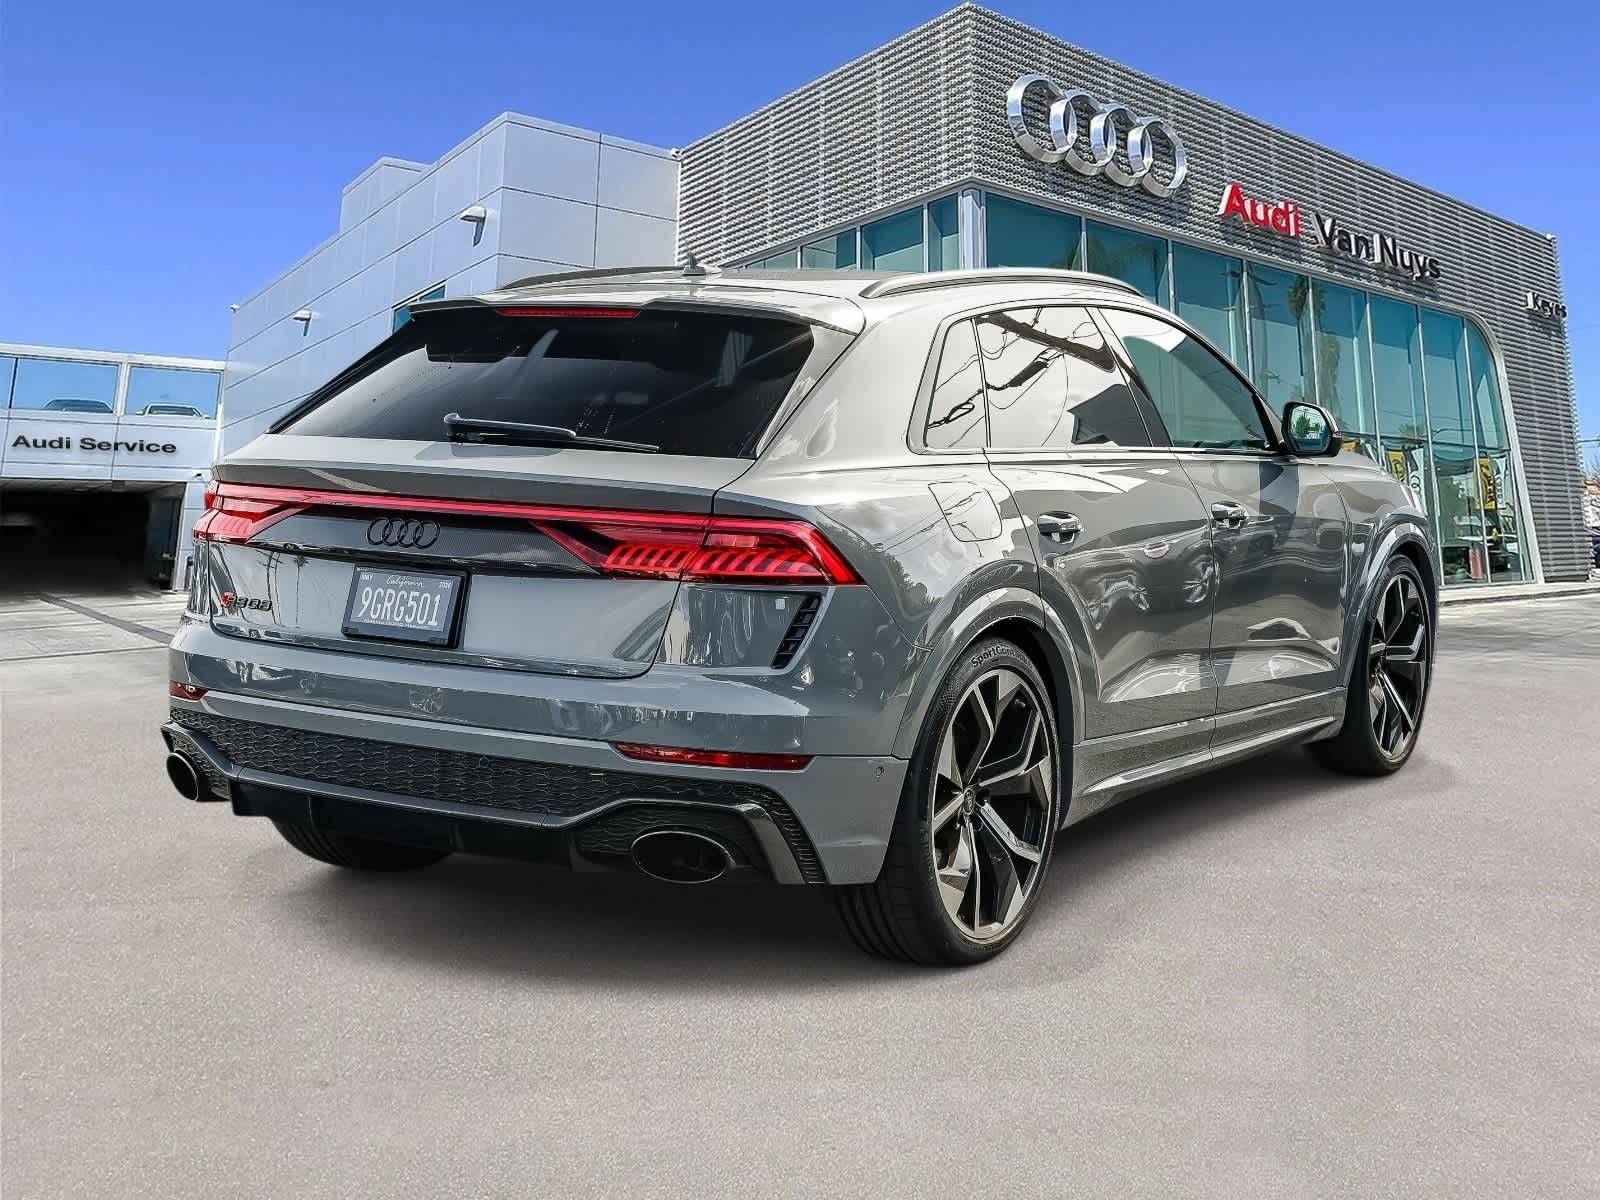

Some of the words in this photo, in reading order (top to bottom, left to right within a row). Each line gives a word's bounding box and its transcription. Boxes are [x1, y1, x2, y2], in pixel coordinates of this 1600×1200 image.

[1218, 183, 1302, 238] Audi
[1312, 212, 1371, 260] Van
[1374, 233, 1441, 280] Nuys
[12, 435, 71, 449] Audi
[79, 437, 177, 453] Service
[358, 587, 440, 626] 9GRG501
